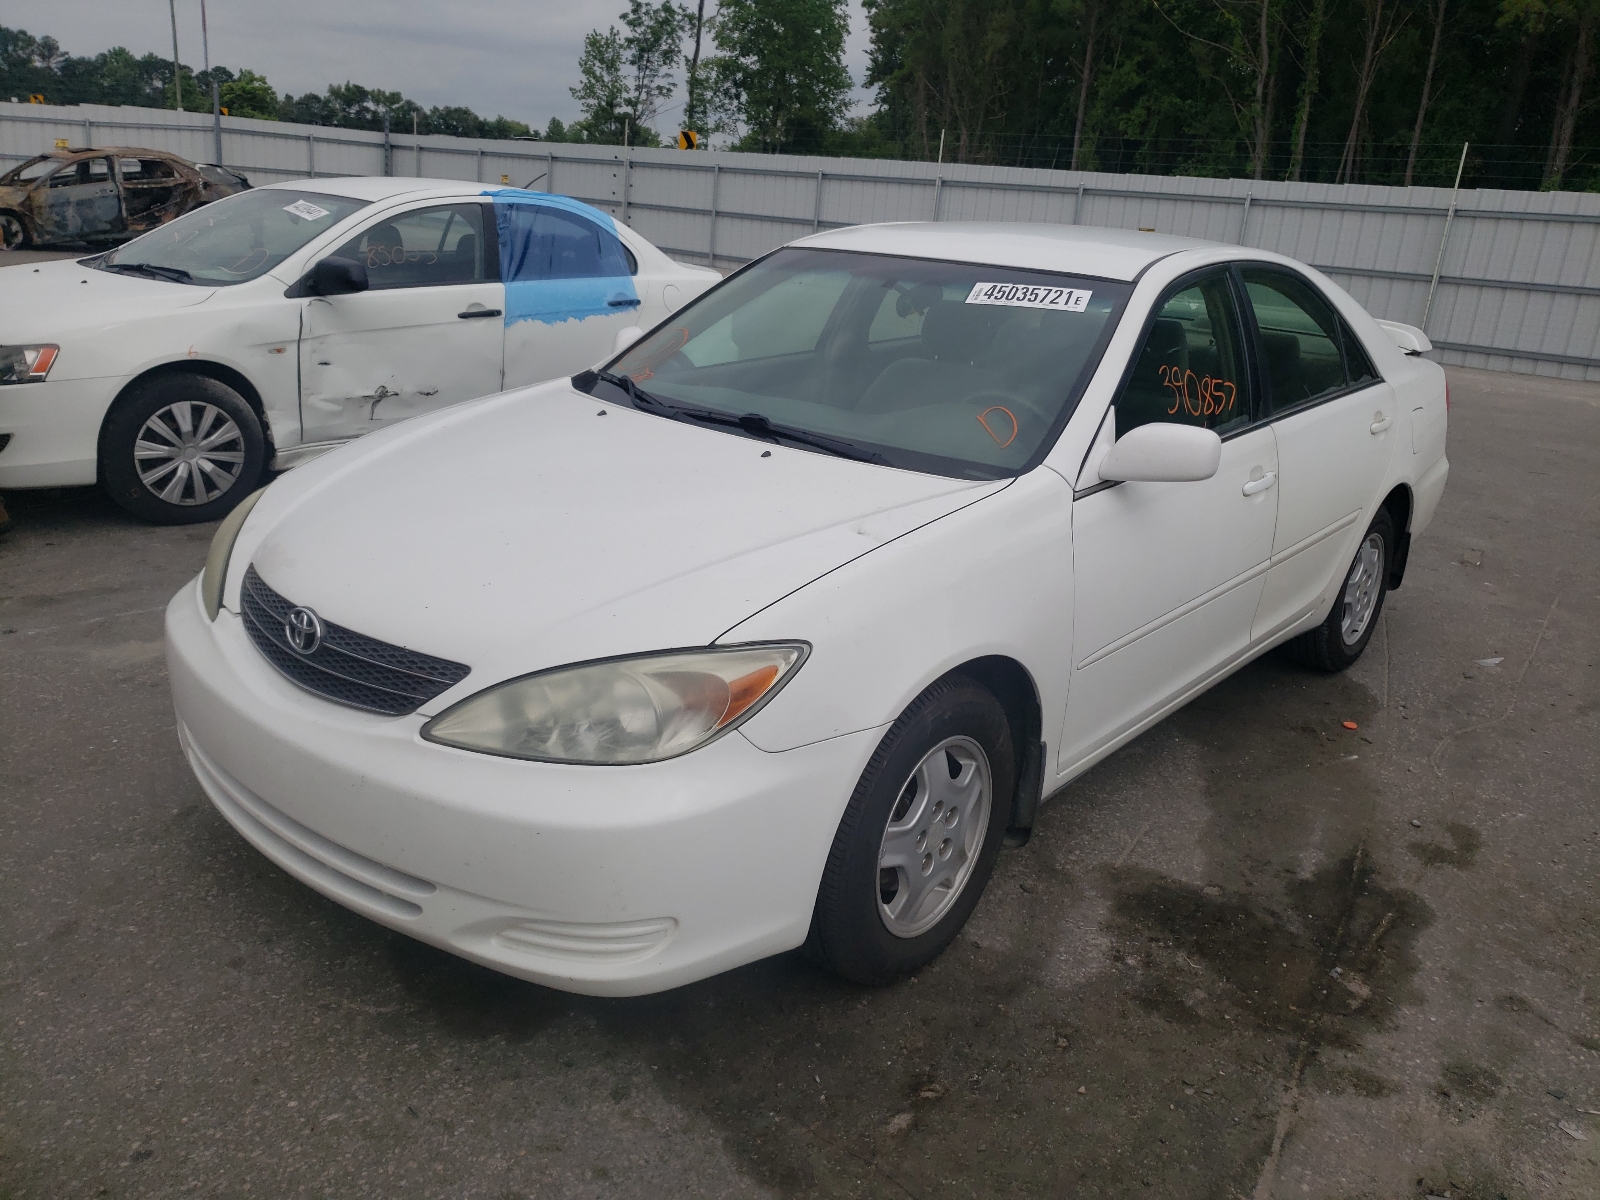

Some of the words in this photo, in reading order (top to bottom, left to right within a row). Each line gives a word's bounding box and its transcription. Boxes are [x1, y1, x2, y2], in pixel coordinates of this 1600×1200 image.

[983, 284, 1073, 306] 45035721
[1074, 296, 1084, 306] E
[1158, 365, 1236, 417] 390857
[976, 405, 1019, 449] D
